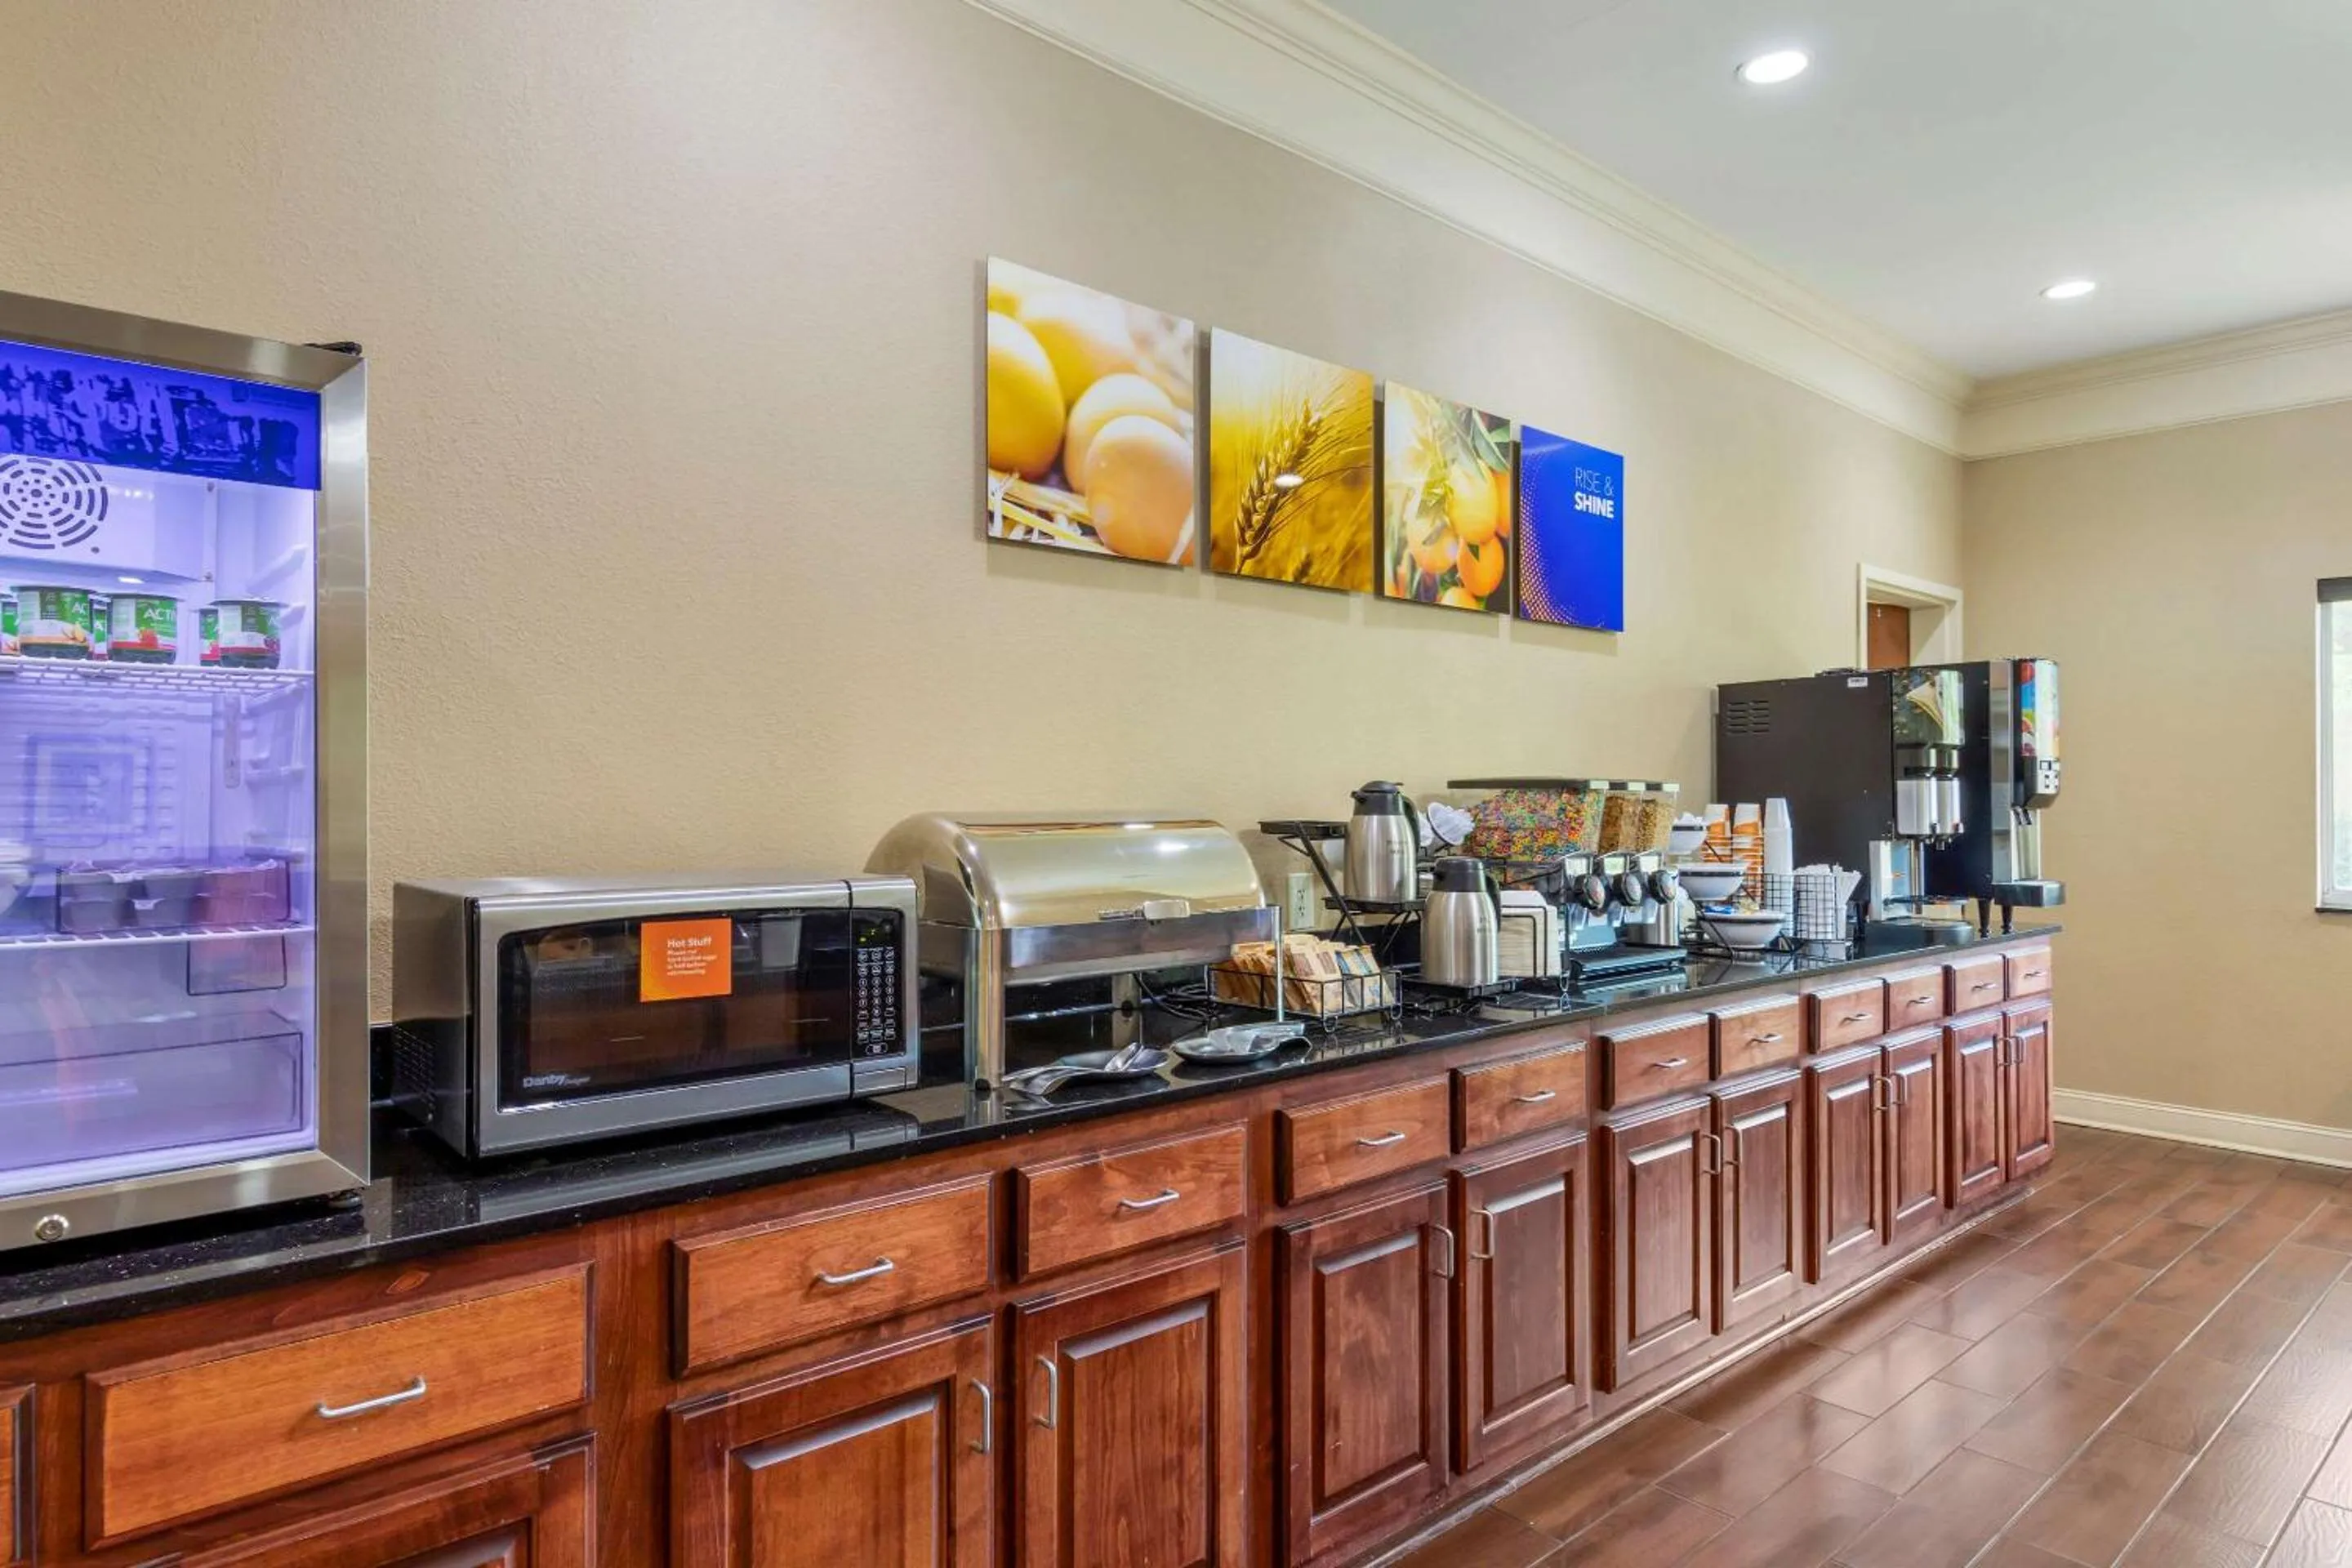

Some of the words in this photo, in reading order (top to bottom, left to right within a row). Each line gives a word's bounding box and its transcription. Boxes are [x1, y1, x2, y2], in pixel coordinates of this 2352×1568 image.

[1575, 466, 1601, 494] RISE
[1604, 476, 1615, 497] &
[1574, 491, 1615, 519] SHINE
[667, 938, 686, 948] Hot
[688, 935, 712, 947] Stuff
